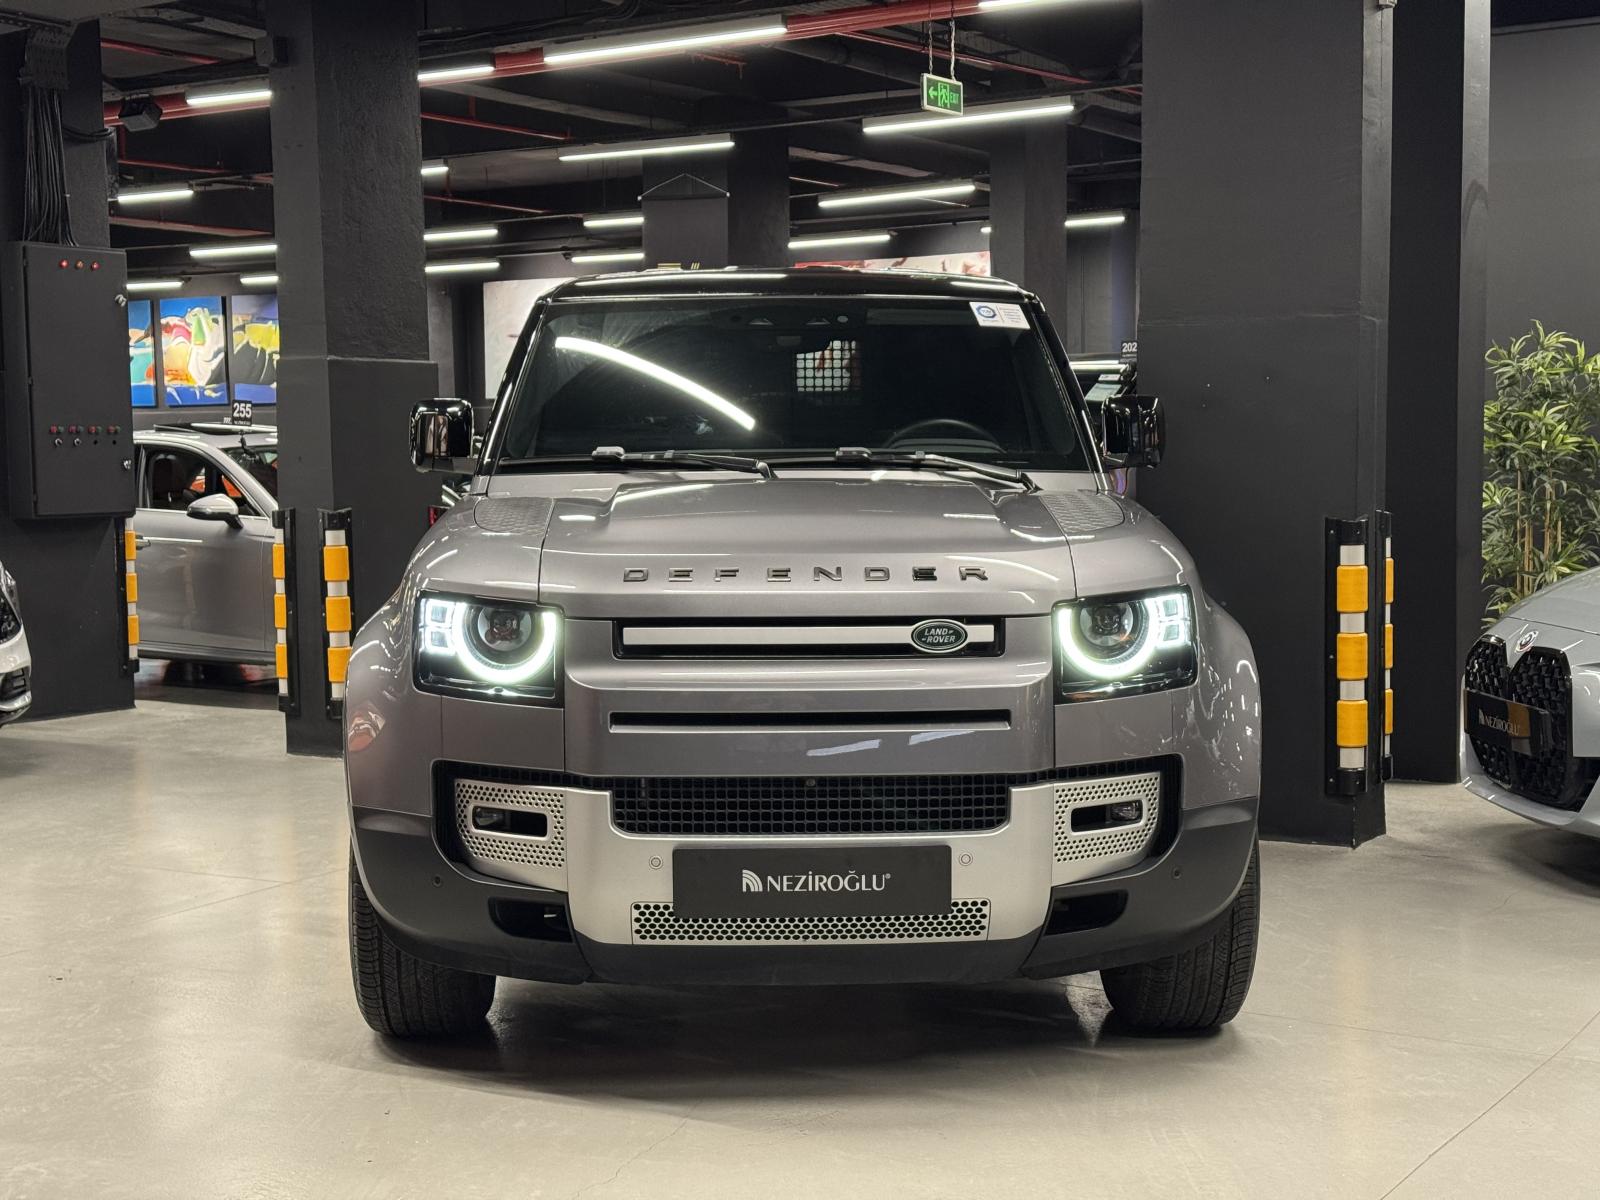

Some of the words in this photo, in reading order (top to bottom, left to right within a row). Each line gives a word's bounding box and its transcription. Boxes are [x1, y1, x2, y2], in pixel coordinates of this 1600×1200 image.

[1122, 342, 1138, 353] 202
[233, 402, 252, 418] 255
[622, 566, 989, 583] DEFENDER
[924, 628, 949, 636] LAND
[926, 635, 956, 643] ROVER
